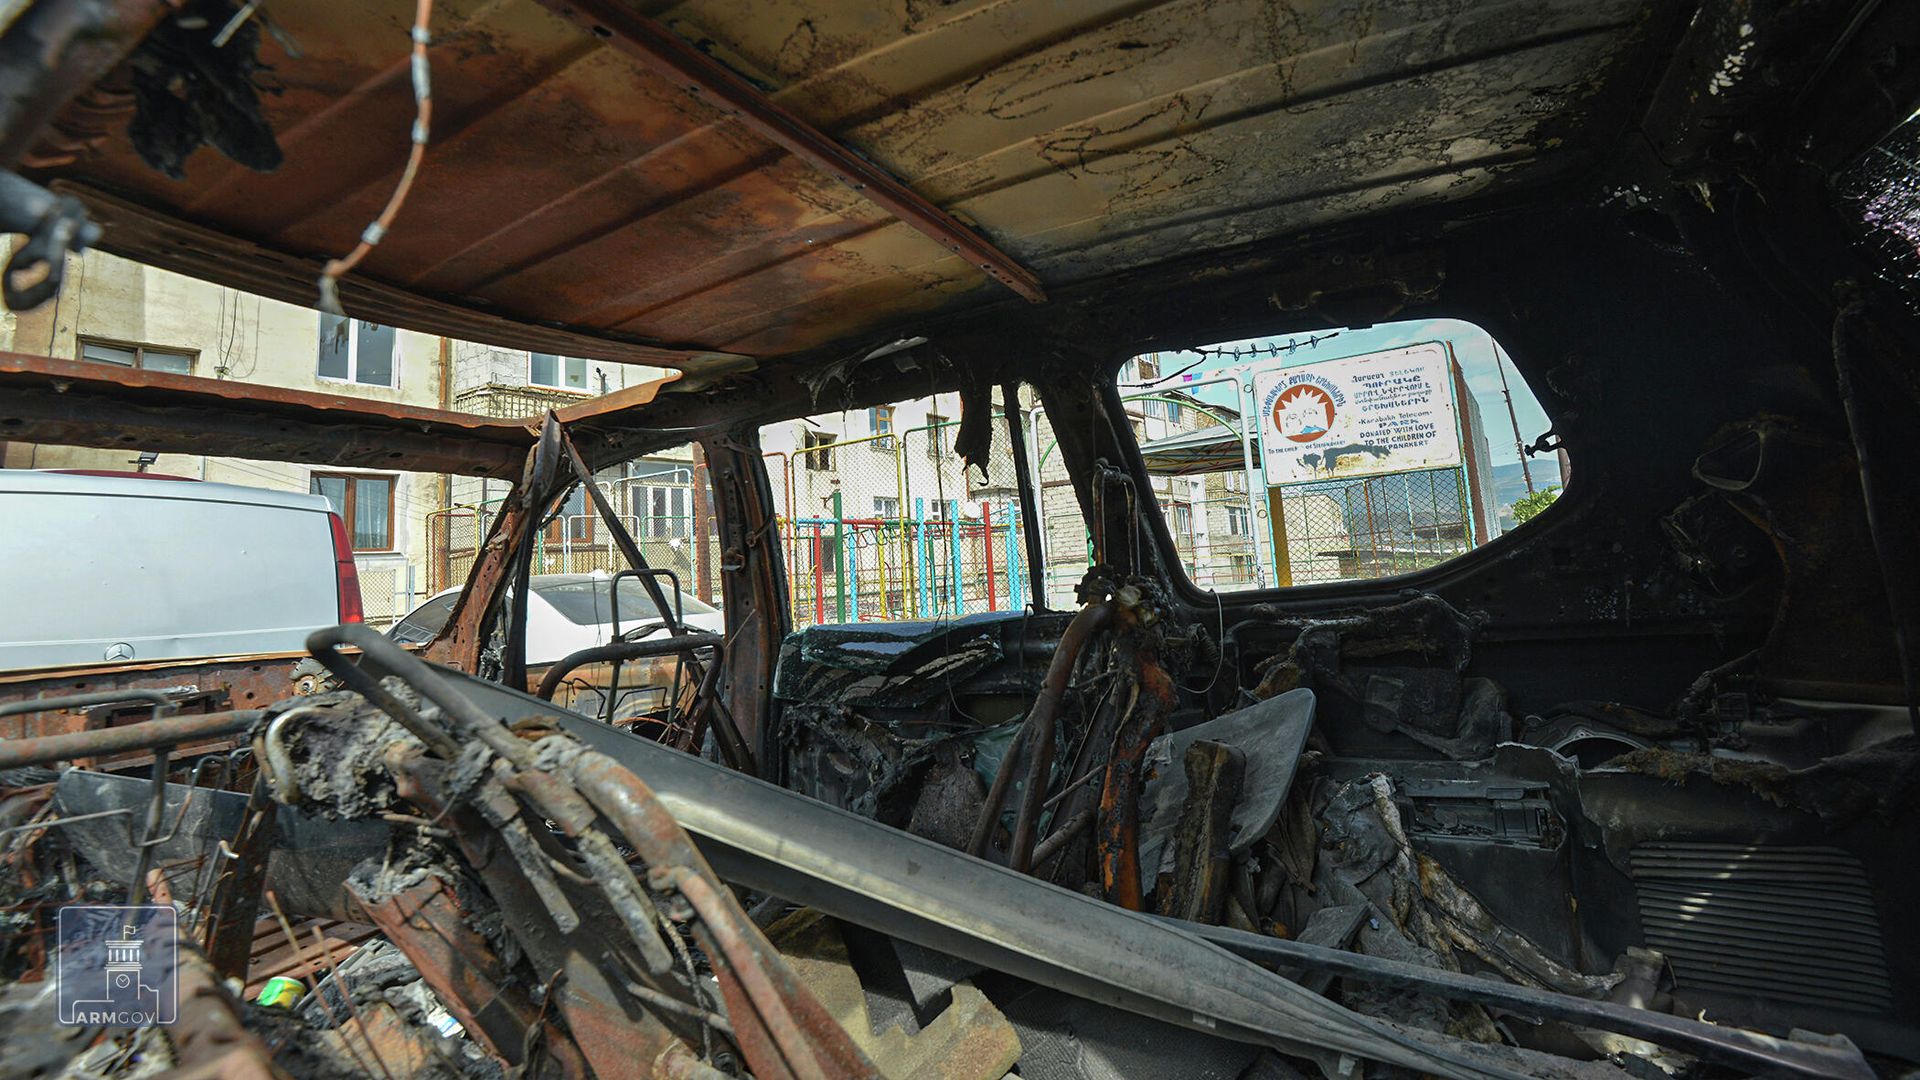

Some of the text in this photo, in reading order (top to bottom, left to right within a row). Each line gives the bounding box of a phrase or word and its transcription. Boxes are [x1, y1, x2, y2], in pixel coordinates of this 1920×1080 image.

[1360, 422, 1434, 439] DONATED WITH LOVE
[1364, 430, 1437, 447] TO THE CHILDREN OF
